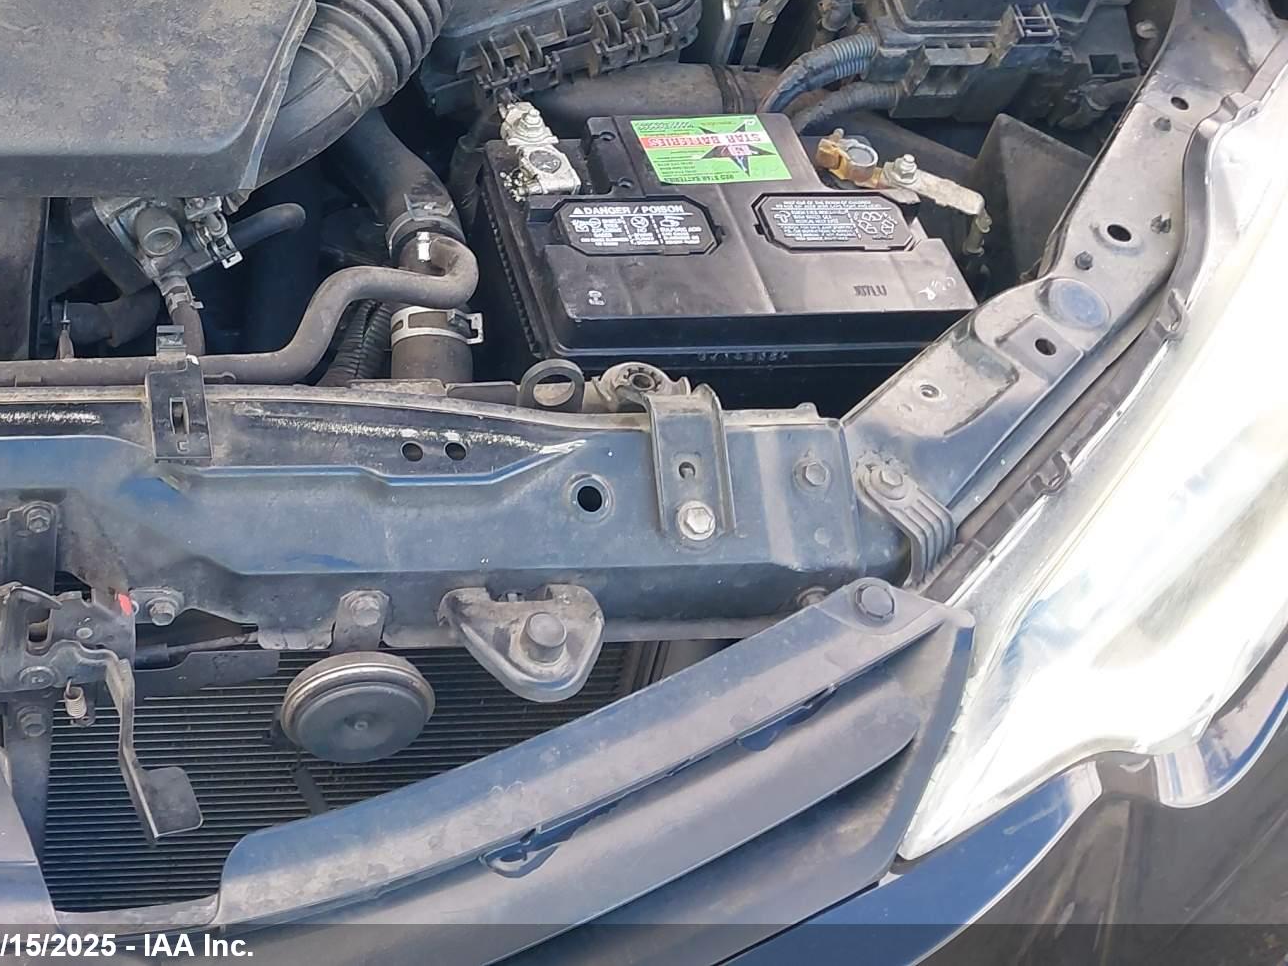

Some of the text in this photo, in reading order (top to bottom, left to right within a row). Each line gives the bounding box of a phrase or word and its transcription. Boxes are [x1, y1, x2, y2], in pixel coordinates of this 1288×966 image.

[648, 133, 761, 147] STAR BATTERIES
[583, 206, 631, 215] DANGER
[642, 205, 685, 213] POISON
